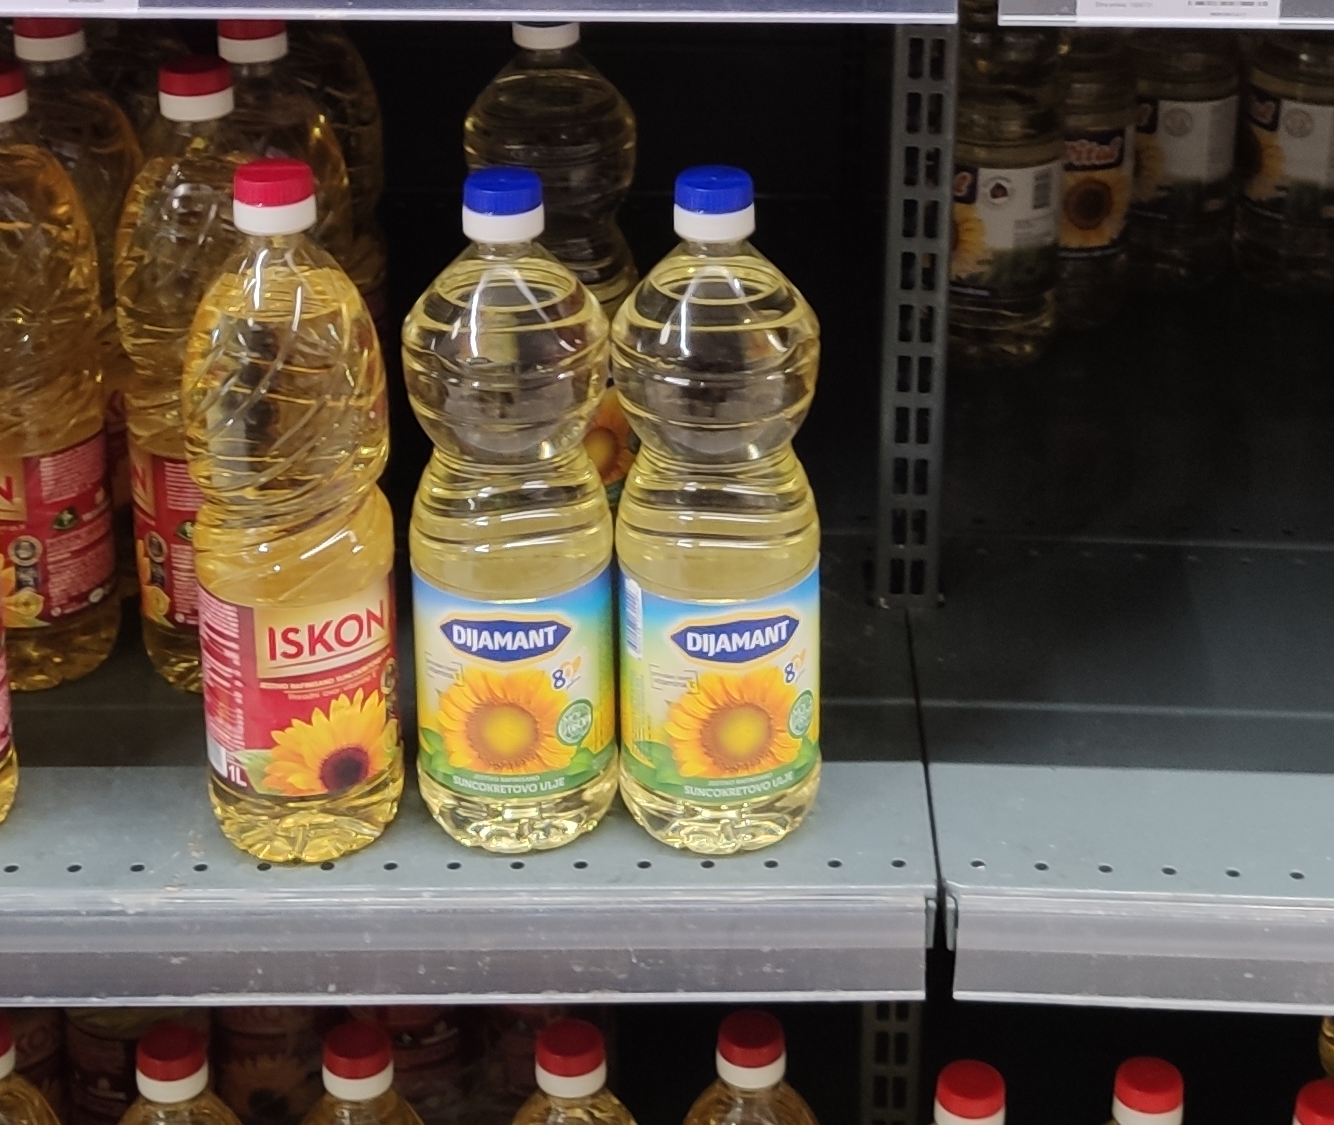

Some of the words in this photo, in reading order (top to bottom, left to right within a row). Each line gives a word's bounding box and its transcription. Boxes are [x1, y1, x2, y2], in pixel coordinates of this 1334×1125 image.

[267, 600, 386, 662] ISKON
[452, 623, 558, 652] DIJAMANT
[686, 620, 790, 657] DIJAMANT
[227, 763, 248, 788] 1L
[452, 775, 538, 794] SUNCOKRETOVO
[539, 776, 565, 791] ULJE
[684, 778, 771, 798] SUNCOKRETOVO
[772, 770, 794, 788] ULJE
